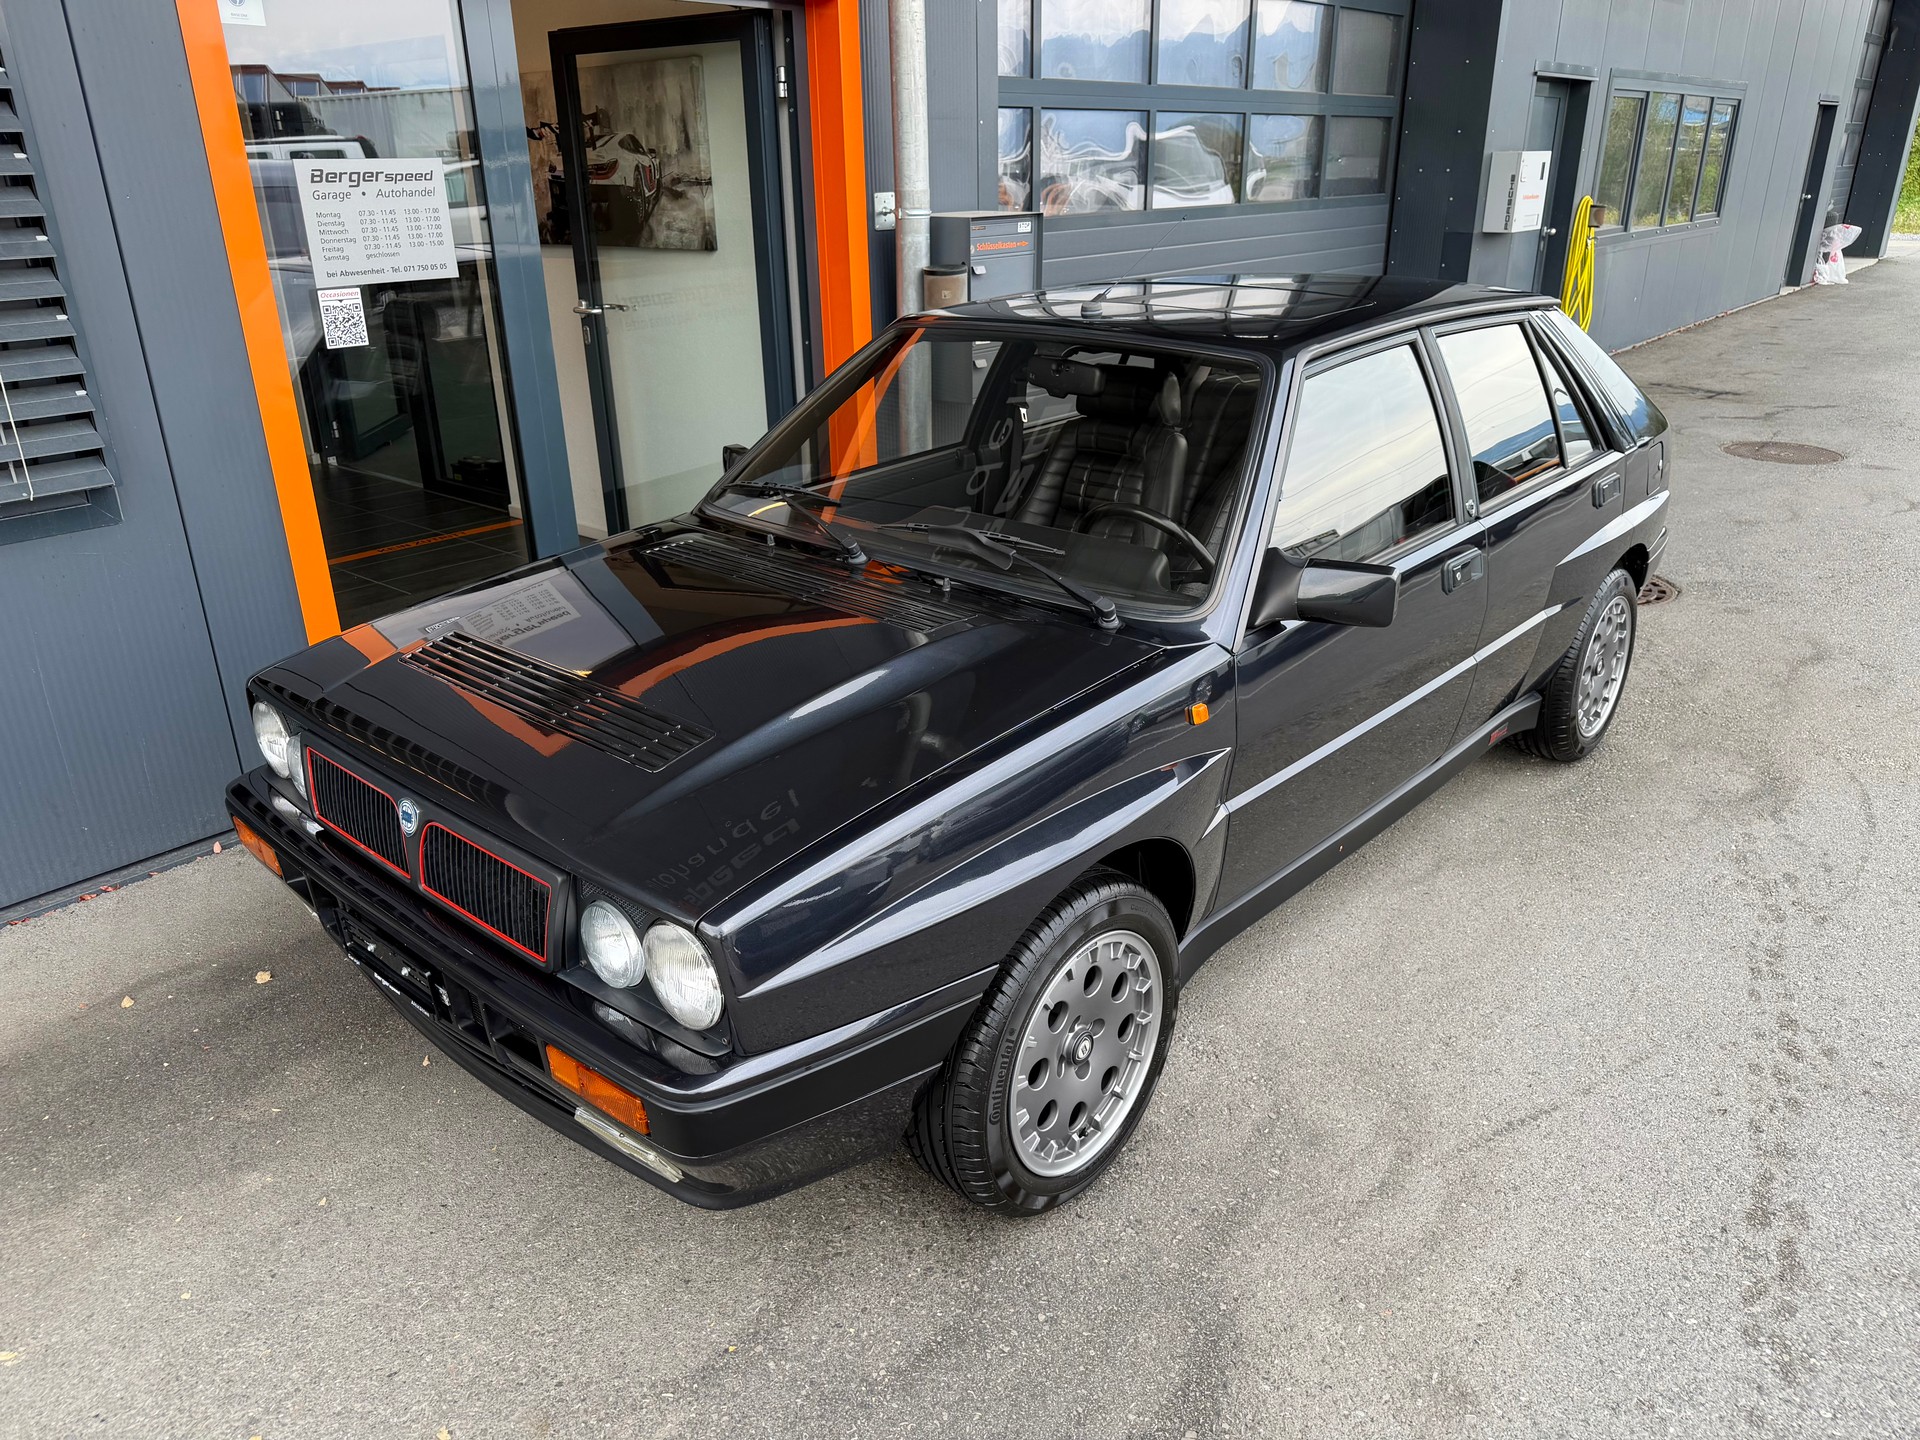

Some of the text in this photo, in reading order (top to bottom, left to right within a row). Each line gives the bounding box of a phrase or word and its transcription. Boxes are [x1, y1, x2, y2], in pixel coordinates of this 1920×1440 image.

[310, 168, 433, 187] Bergerspeed
[312, 187, 435, 202] Garage Autohandel
[316, 211, 341, 219] Montag
[317, 220, 345, 228] Dienstag
[319, 228, 349, 236] Mittwoch
[361, 226, 378, 234] 07.30
[383, 225, 399, 233] 11.45
[406, 224, 422, 232] 13.00
[320, 236, 357, 245] Donnerstag
[362, 234, 379, 242] 07.30
[408, 232, 423, 240] 13.00
[364, 243, 381, 251] 07.30
[976, 241, 1017, 251] Schlüsselkasten
[323, 251, 400, 262] Samstag geschlossen
[326, 270, 338, 278] bei
[340, 267, 385, 277] Abwesenheit
[404, 265, 416, 273] 071
[417, 264, 429, 272] 750
[430, 263, 438, 271] 05
[439, 262, 447, 270] 05
[320, 291, 359, 299] Occasionen
[988, 1034, 1015, 1126] Continental
